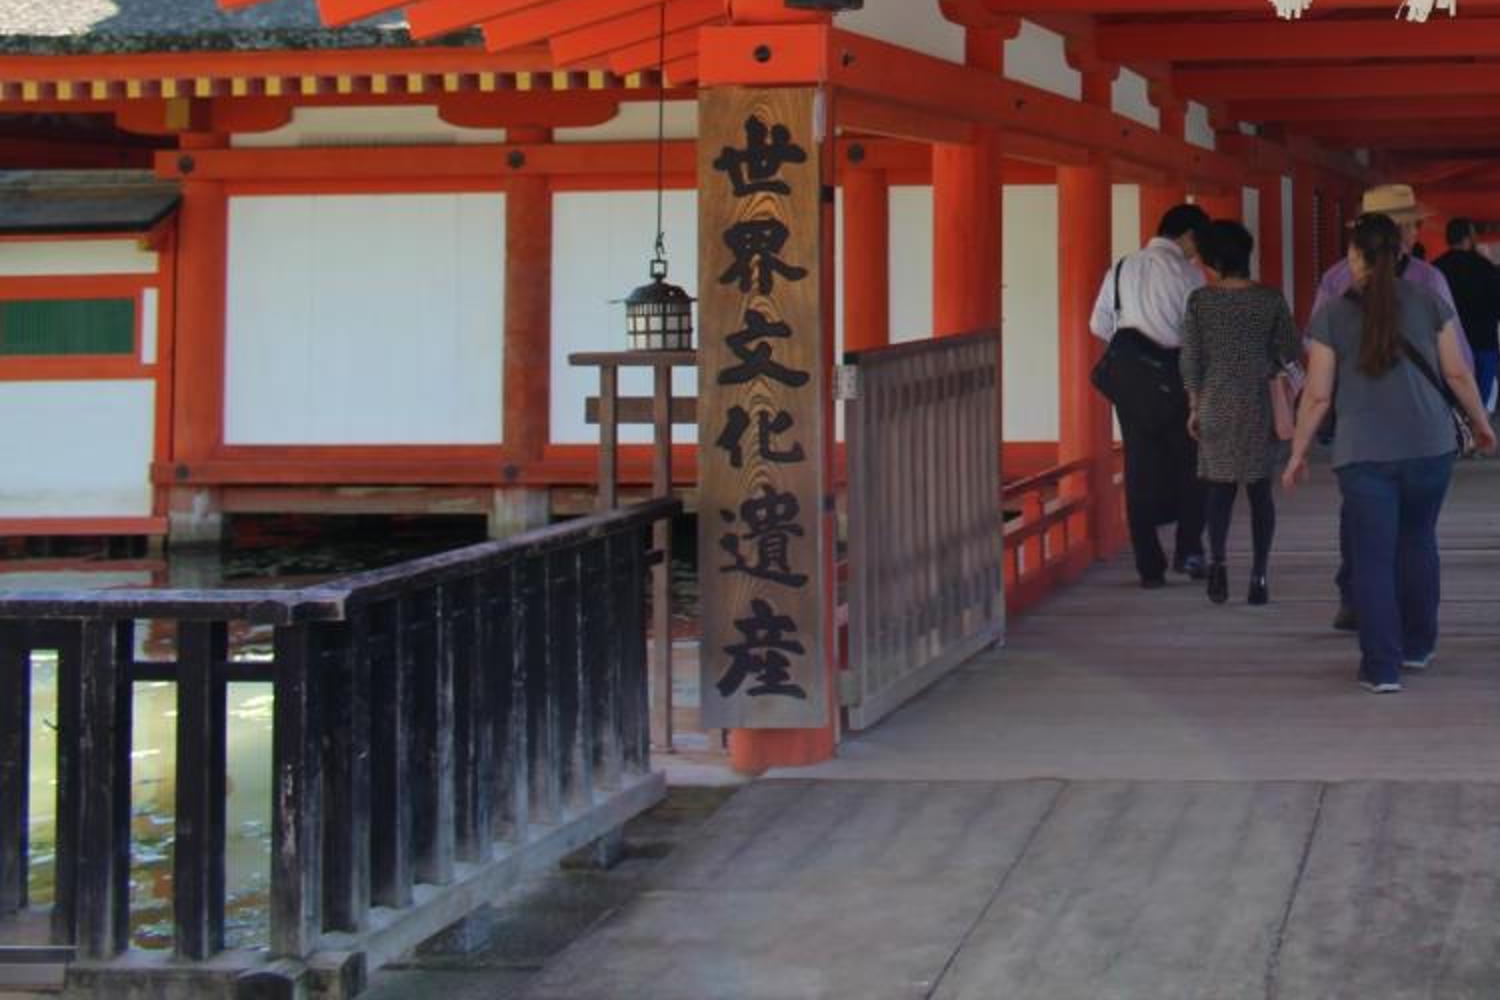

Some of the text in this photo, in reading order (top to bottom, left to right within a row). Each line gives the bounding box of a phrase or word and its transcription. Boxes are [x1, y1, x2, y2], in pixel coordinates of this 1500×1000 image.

[714, 115, 809, 698] 世界文化遺産
